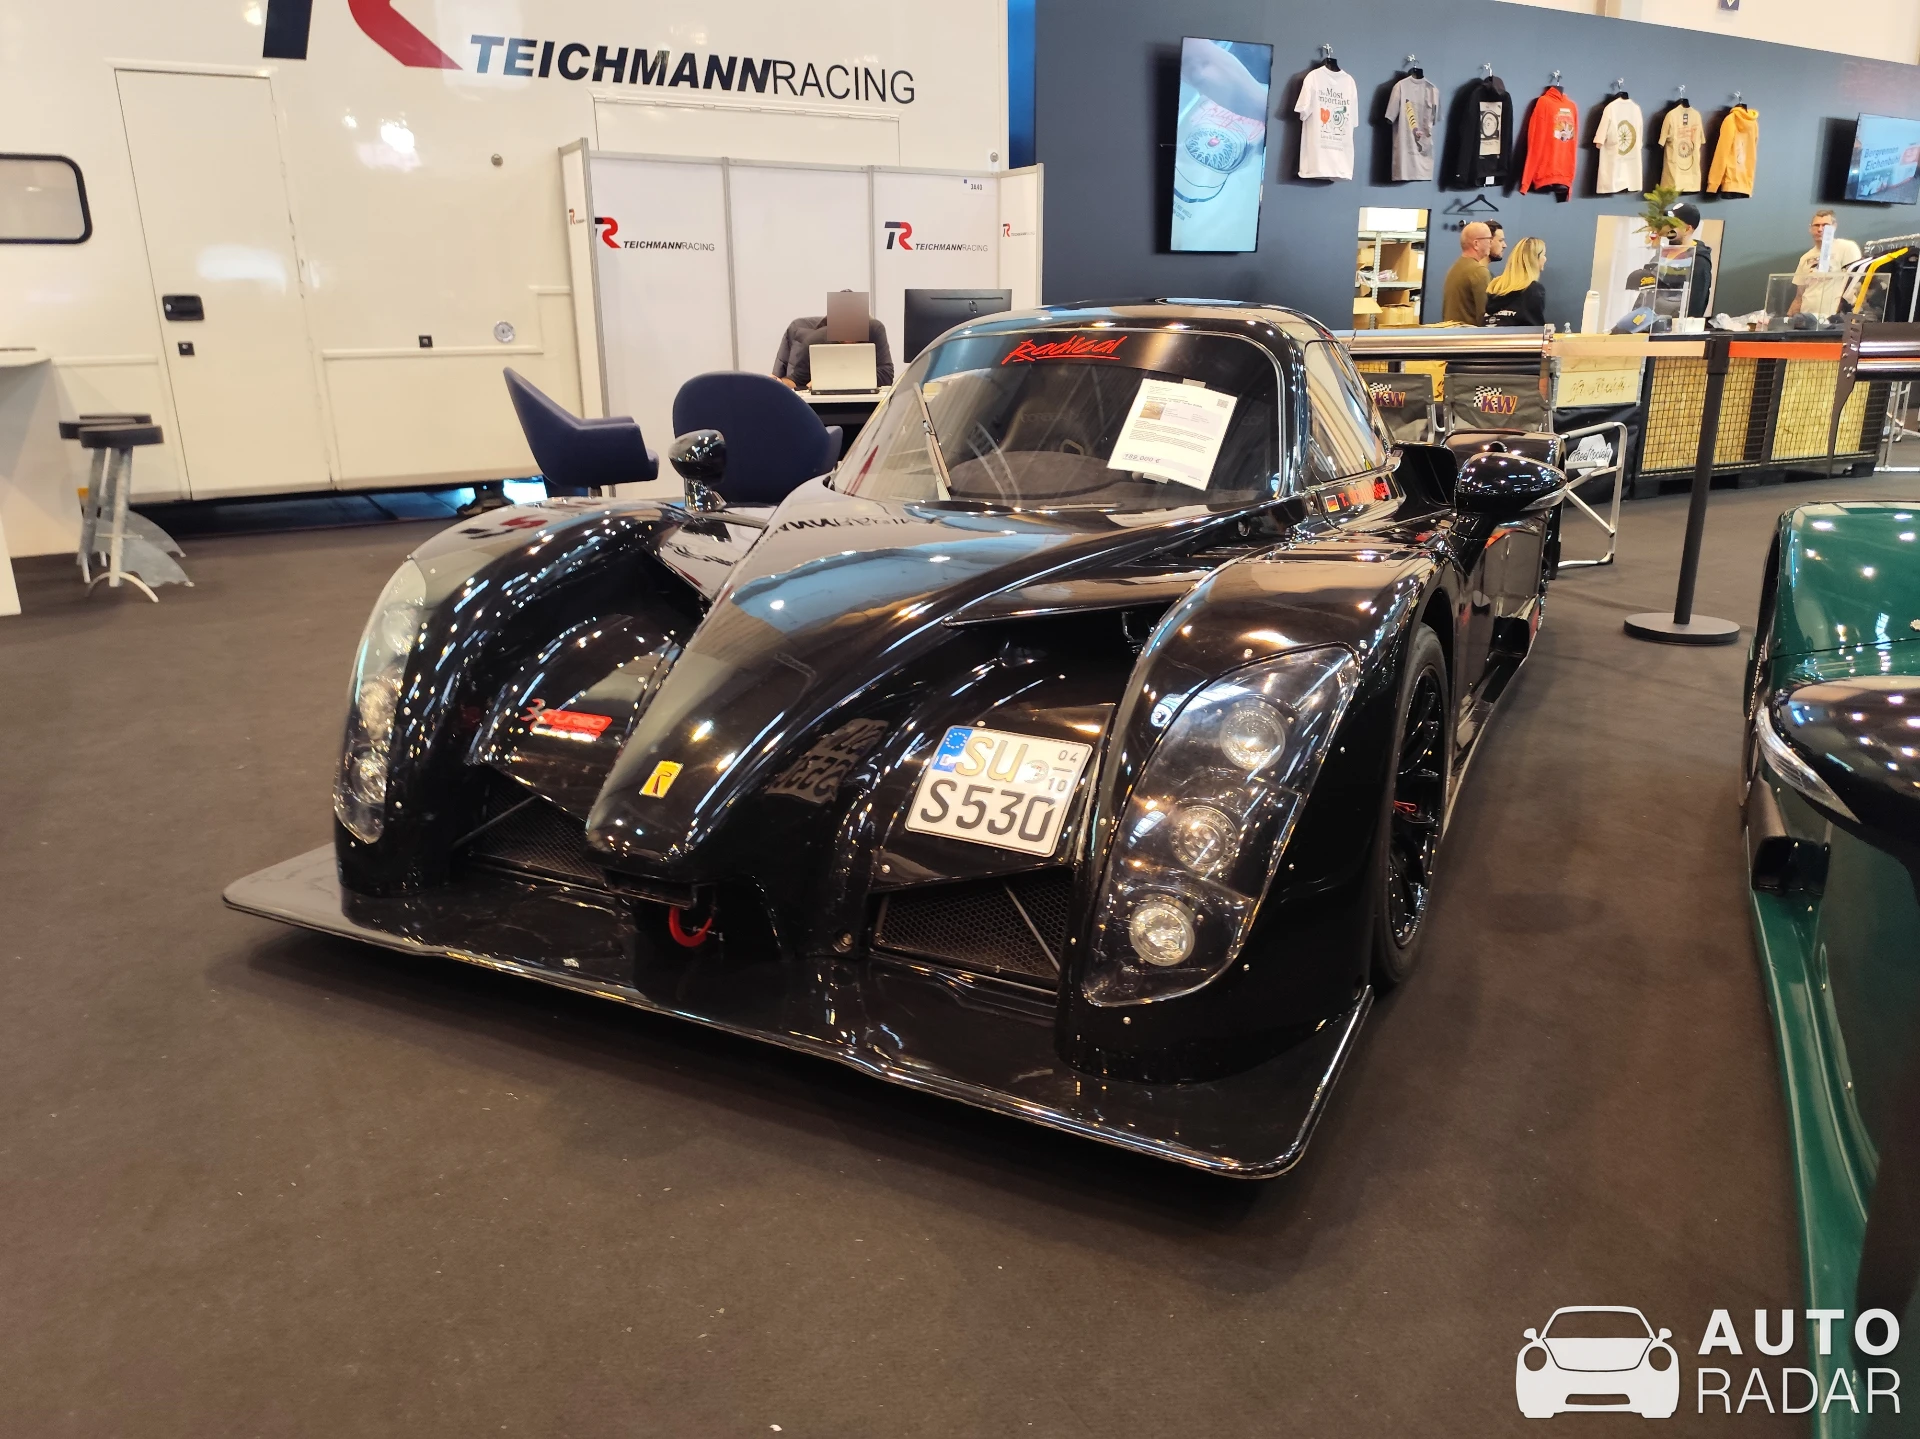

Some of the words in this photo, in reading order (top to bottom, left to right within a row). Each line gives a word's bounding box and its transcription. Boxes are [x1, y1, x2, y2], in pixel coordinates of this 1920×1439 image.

[470, 34, 915, 104] TEICHMANNRACING
[1318, 96, 1350, 106] mportant
[1326, 88, 1343, 99] Most
[623, 240, 715, 251] TEICHMANNRACING
[915, 243, 988, 252] TEICHMANNRACING
[1001, 335, 1127, 365] Radical
[1374, 391, 1406, 408] KW
[1481, 395, 1518, 414] KW
[955, 736, 1029, 782] SU
[1057, 749, 1078, 763] 04
[1048, 777, 1068, 792] 10
[920, 778, 1057, 842] S530
